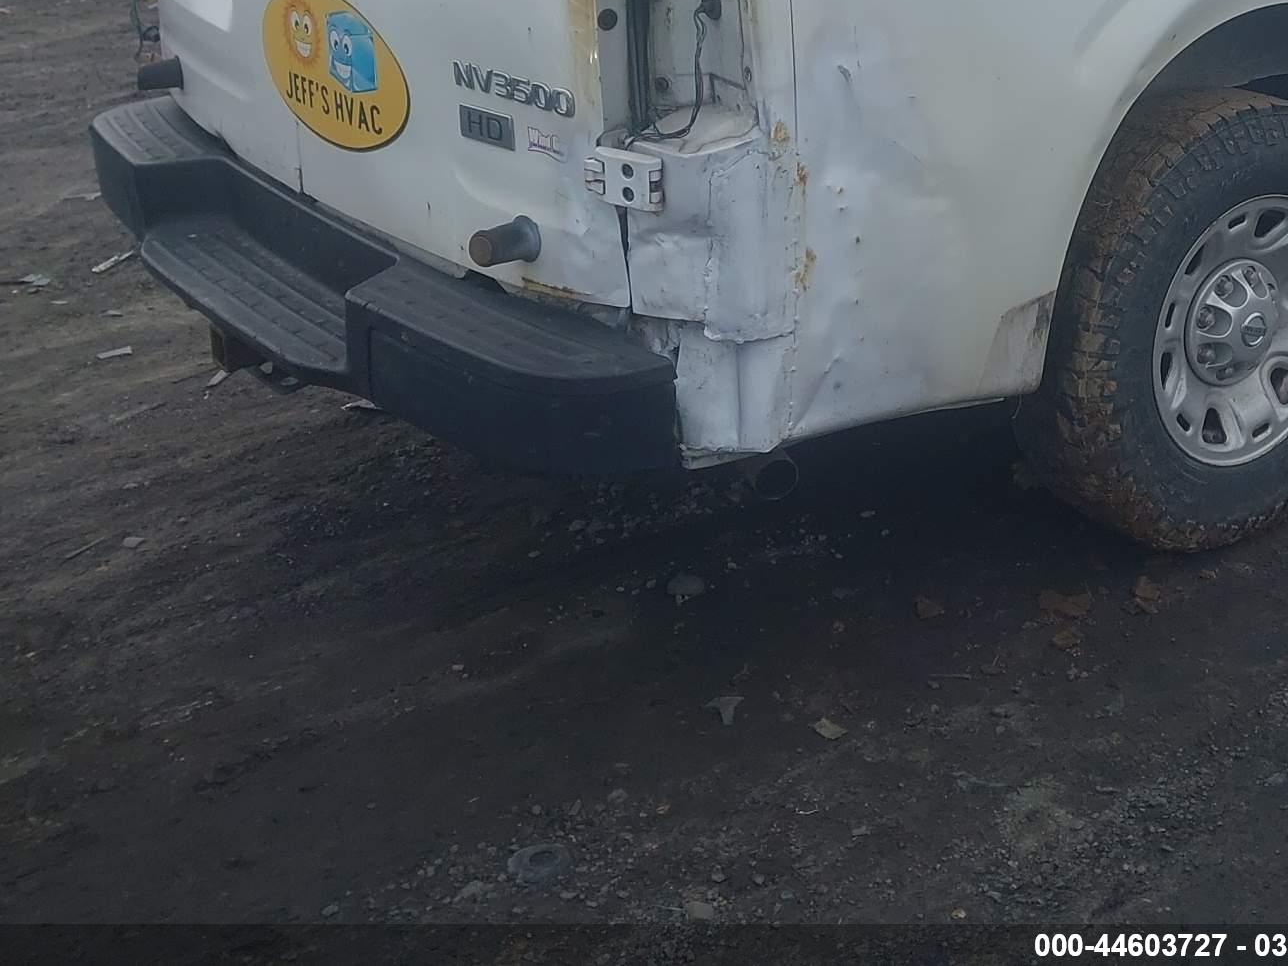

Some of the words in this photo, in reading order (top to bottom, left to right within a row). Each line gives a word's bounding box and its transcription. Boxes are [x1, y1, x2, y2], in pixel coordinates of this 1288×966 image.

[286, 71, 330, 115] JEFF'S
[334, 90, 383, 135] HVAC
[453, 59, 575, 117] NV3500
[467, 110, 503, 141] HD
